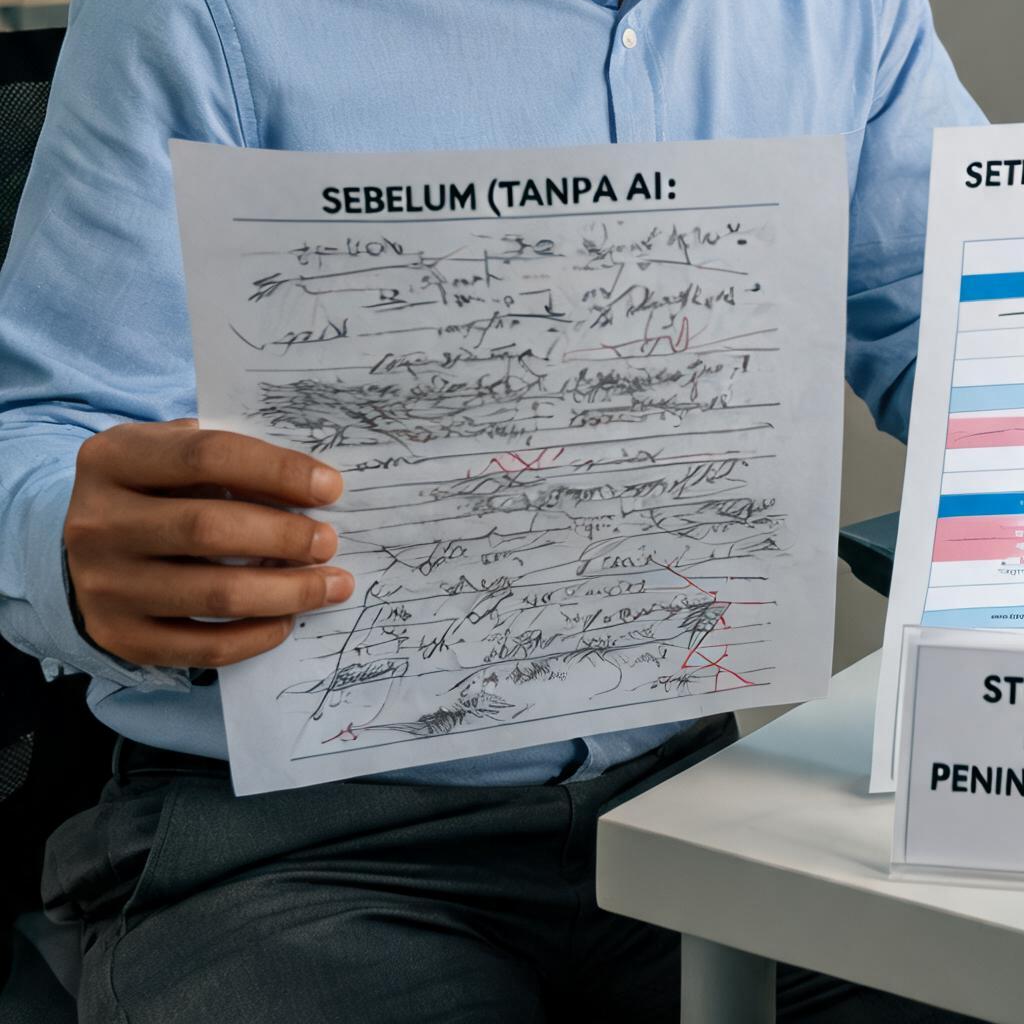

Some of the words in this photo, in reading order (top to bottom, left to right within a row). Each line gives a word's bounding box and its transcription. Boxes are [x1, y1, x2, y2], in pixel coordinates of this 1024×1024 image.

[320, 182, 477, 215] SEBELUM
[486, 174, 619, 218] (TANPA
[625, 171, 677, 202] AI:
